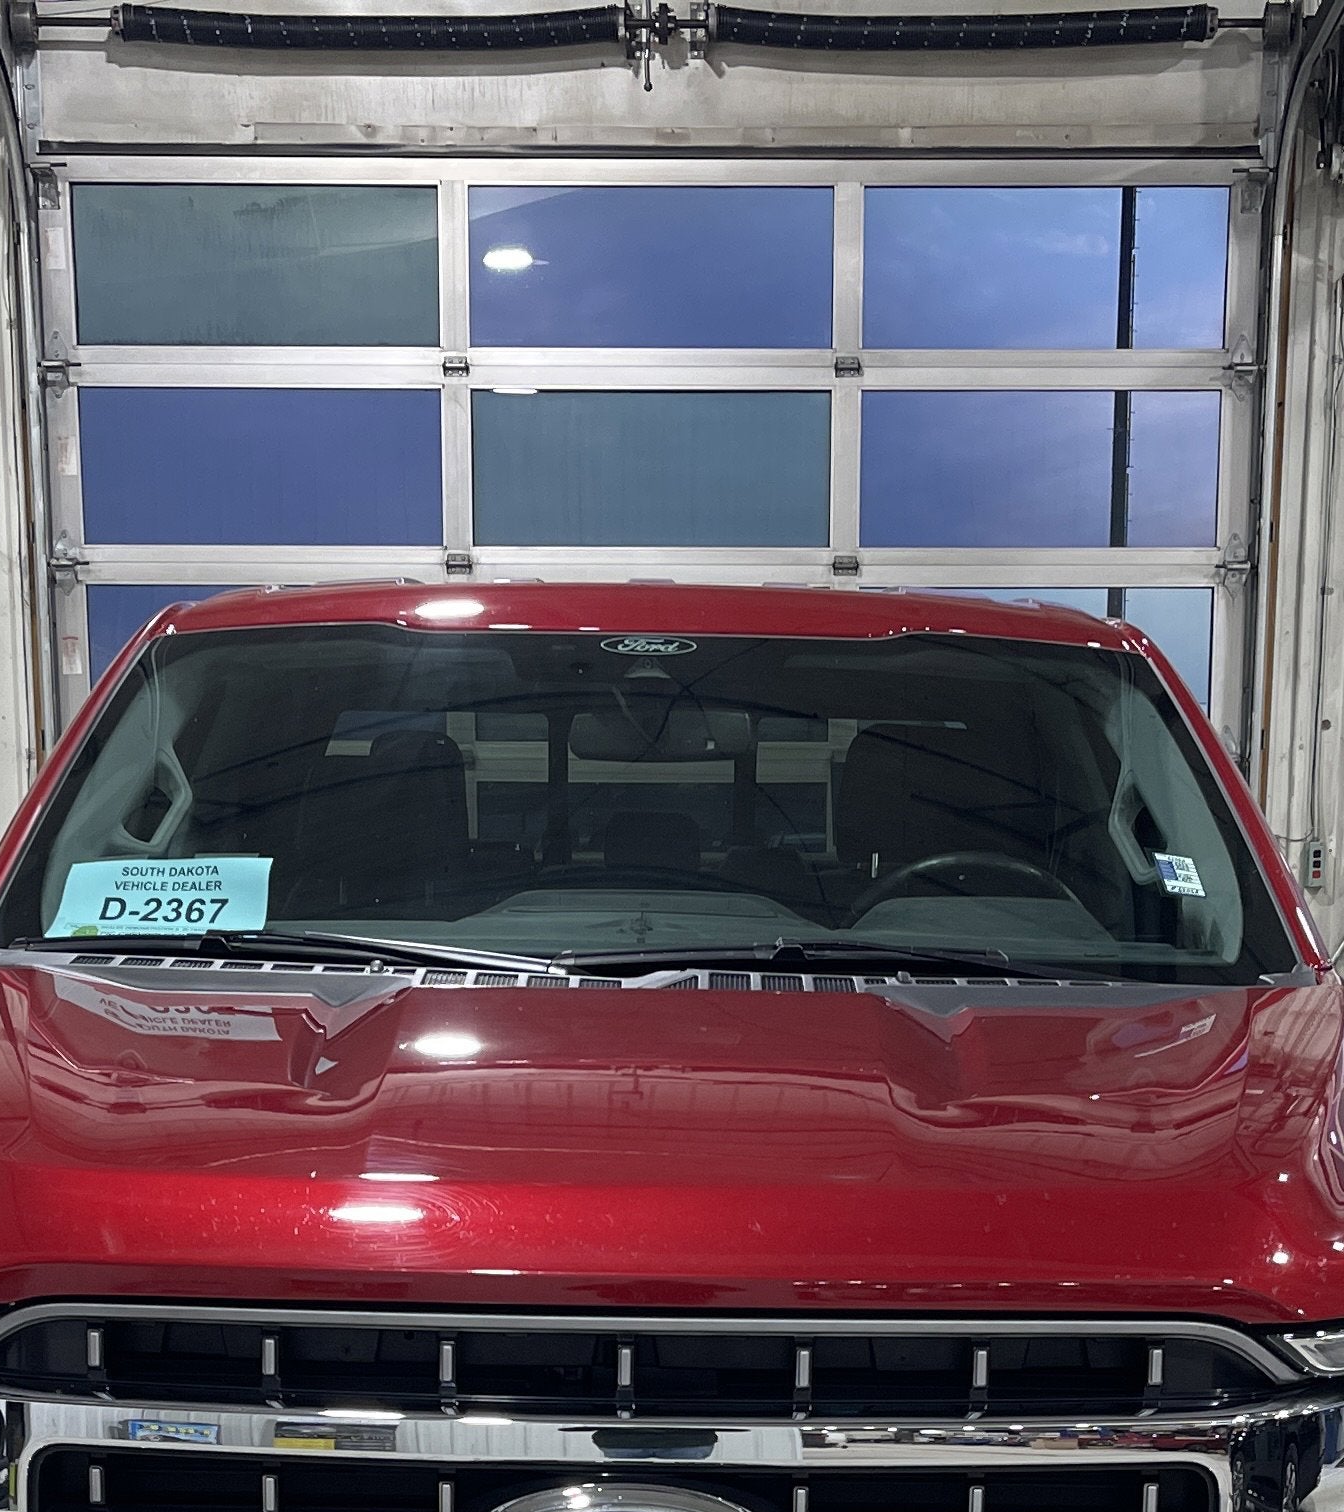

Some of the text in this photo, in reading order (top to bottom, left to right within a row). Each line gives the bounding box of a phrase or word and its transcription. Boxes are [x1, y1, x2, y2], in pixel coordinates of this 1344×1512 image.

[617, 637, 680, 653] Ford
[122, 866, 219, 877] SOUTH DAKOTA
[115, 881, 222, 891] VEHICLE DEALER
[99, 897, 229, 923] D-2367
